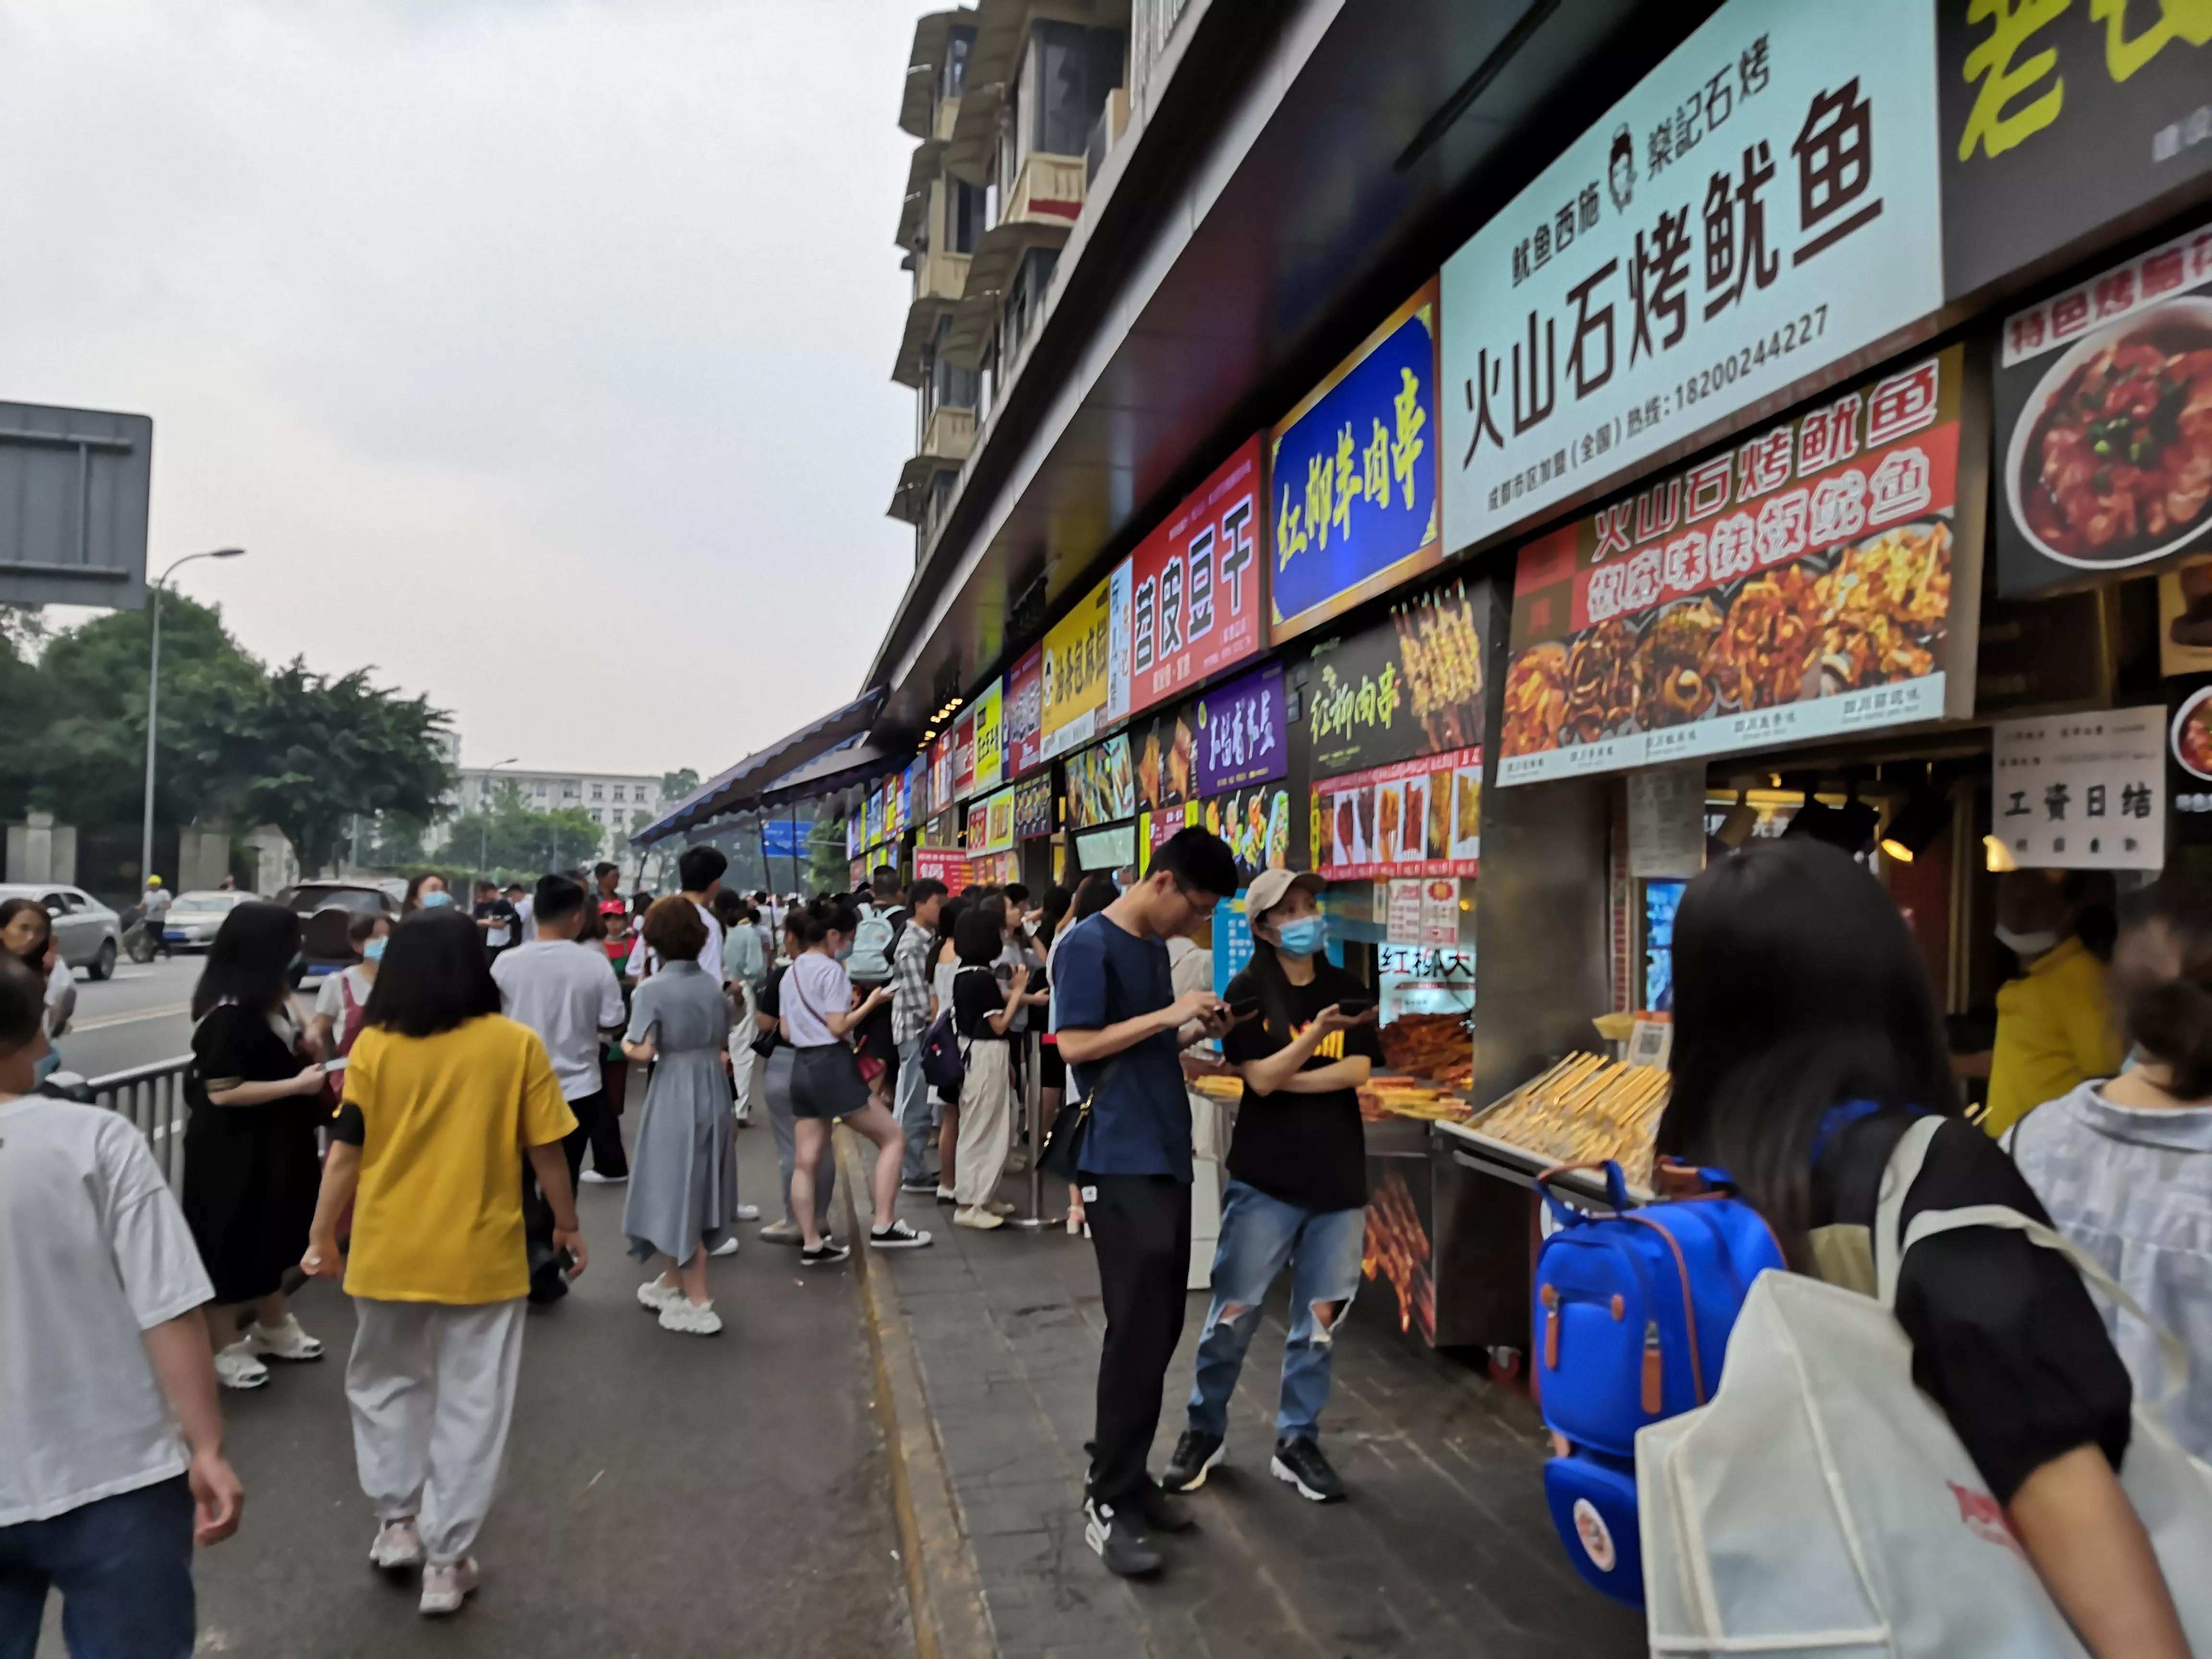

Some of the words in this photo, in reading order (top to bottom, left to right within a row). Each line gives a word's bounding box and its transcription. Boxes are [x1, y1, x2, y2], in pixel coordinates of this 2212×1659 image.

[1463, 75, 1884, 471] 火山石烤鱿鱼
[1512, 179, 1601, 288] 鱿鱼西施
[1591, 357, 1939, 562] 火山石烤鱿鱼
